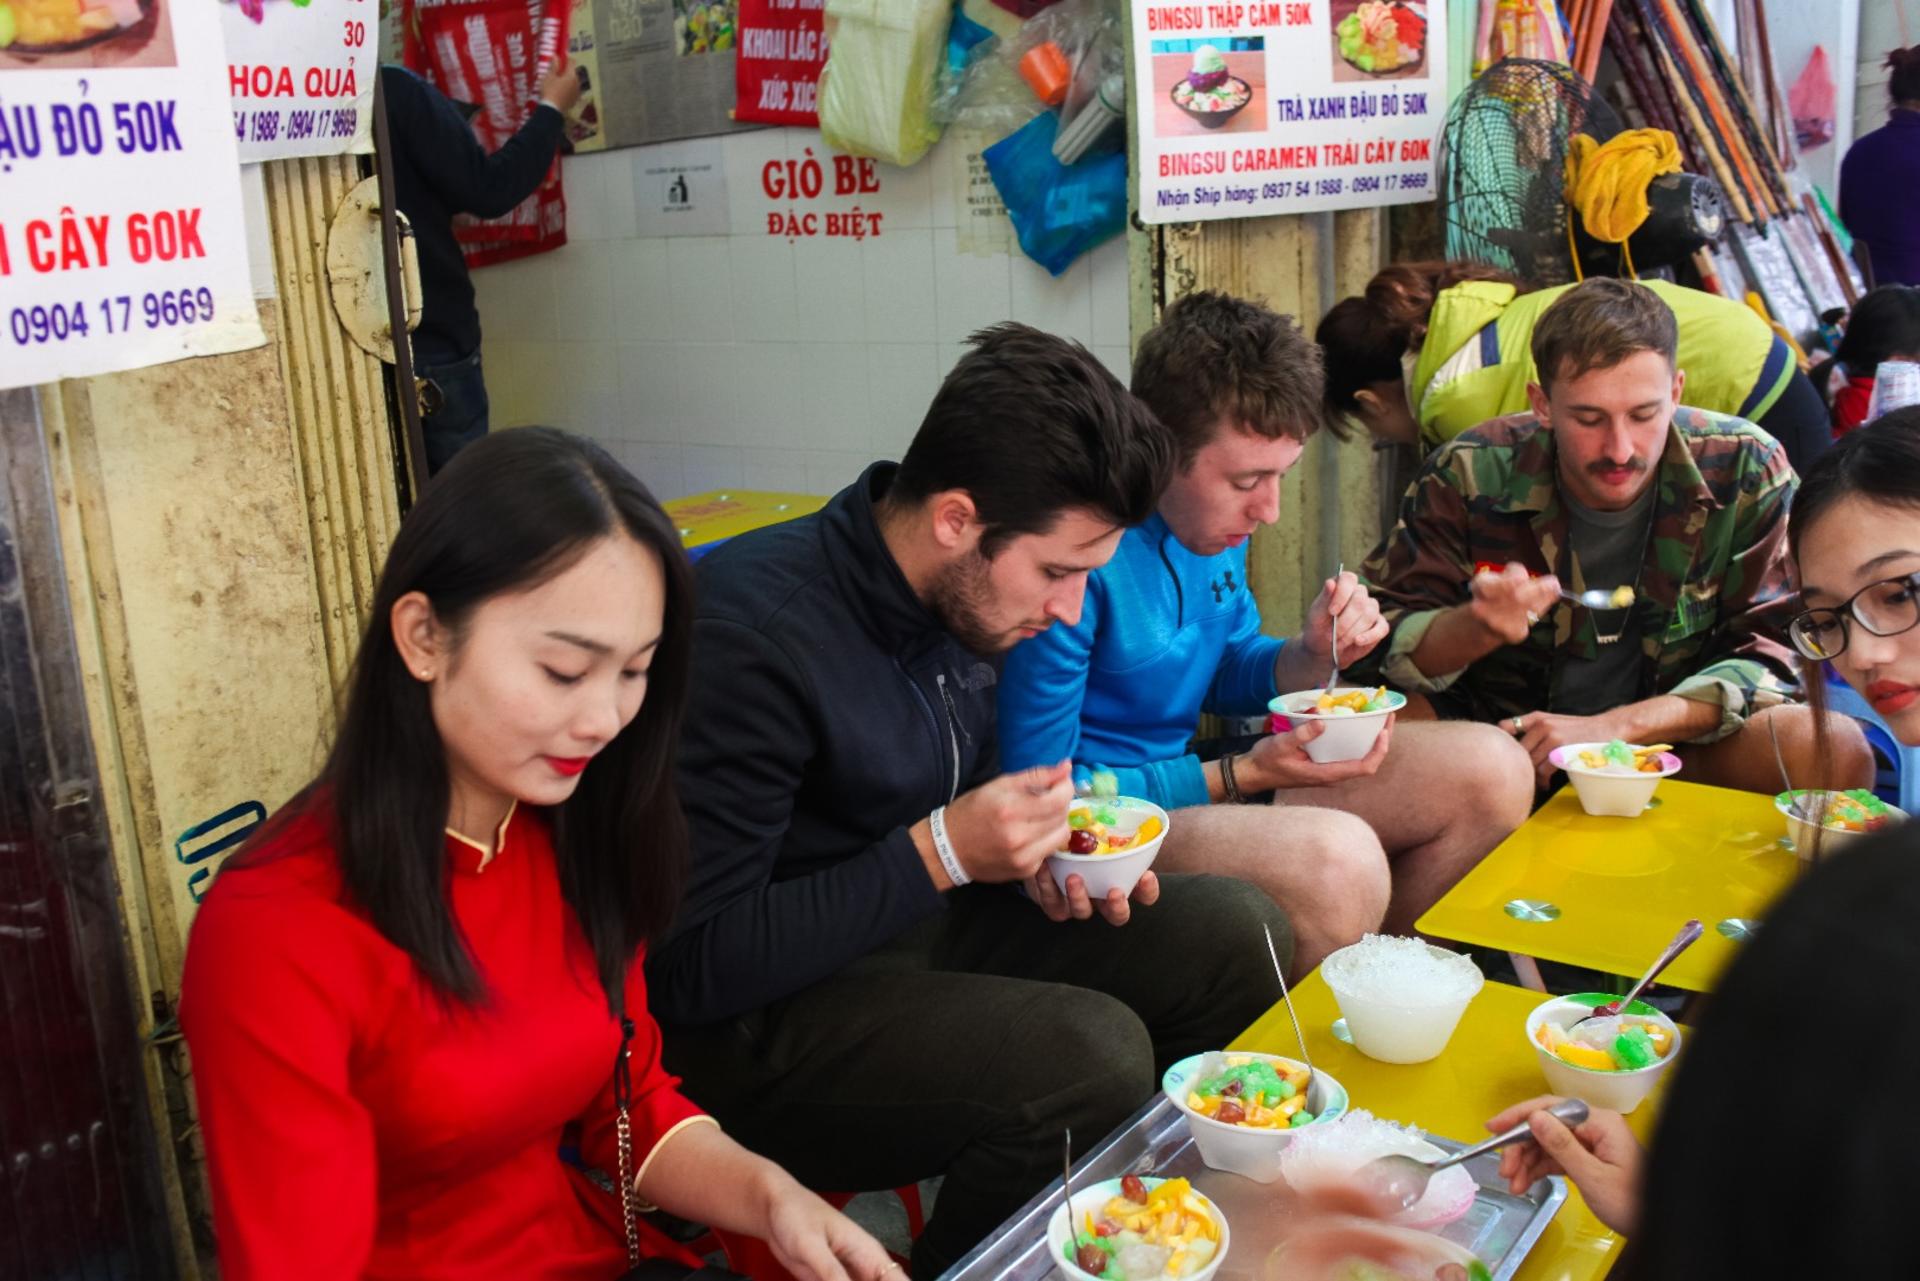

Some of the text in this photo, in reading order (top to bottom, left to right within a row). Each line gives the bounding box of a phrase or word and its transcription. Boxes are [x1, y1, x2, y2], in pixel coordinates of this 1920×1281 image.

[343, 21, 365, 47] 30
[1147, 6, 1203, 31] BINGSU
[1285, 3, 1312, 26] 50K
[742, 27, 787, 60] KHOAI
[228, 56, 357, 98] HOA QUẢ
[758, 74, 817, 112] XÚC XÍC
[50, 79, 103, 156] ĐỎ
[113, 100, 183, 154] 50K
[1309, 97, 1346, 120] XANH
[1403, 92, 1428, 115] 50K
[251, 110, 280, 142] 1988
[287, 110, 316, 140] 0904
[317, 109, 331, 138] 17
[761, 147, 824, 200] GIÒ
[1159, 151, 1225, 177] BINGSU
[1232, 146, 1317, 173] CARAMEN
[1401, 139, 1430, 162] 60K
[1194, 186, 1221, 207] Ship
[1262, 182, 1292, 199] 0937
[1295, 181, 1310, 197] 54
[1315, 178, 1342, 195] 1988
[1352, 176, 1380, 193] 0904
[1385, 174, 1398, 190] 17
[1400, 172, 1428, 189] 9669
[25, 206, 110, 273] CÂY
[127, 208, 206, 262] 60K
[825, 206, 883, 242] BIỆT
[10, 286, 214, 346] 0904 17 9669
